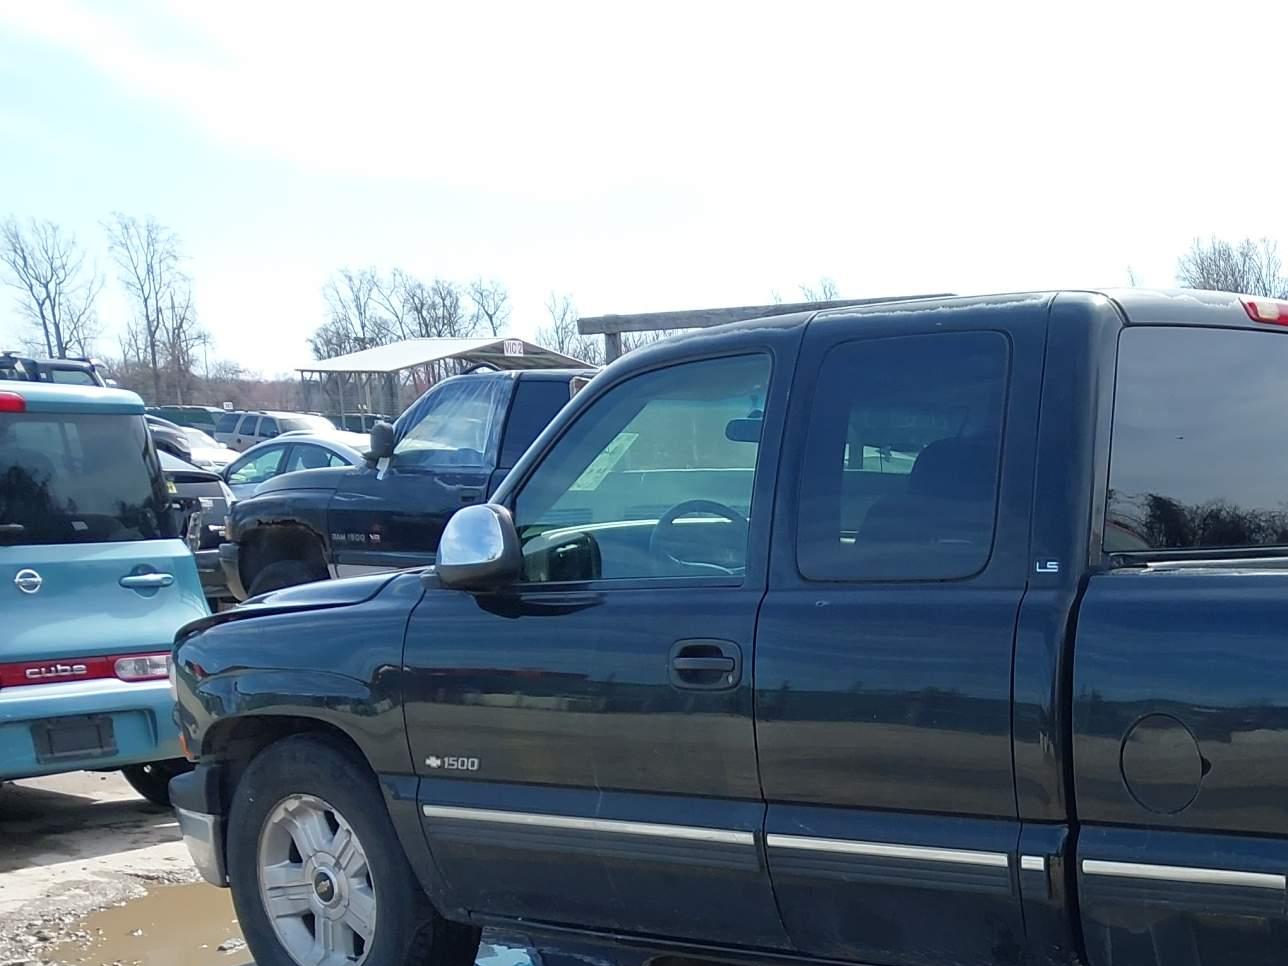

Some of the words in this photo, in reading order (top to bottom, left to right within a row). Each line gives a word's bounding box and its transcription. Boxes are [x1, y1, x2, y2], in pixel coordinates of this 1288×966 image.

[1036, 561, 1059, 573] LS
[25, 664, 88, 679] cube
[443, 756, 479, 770] 1500
